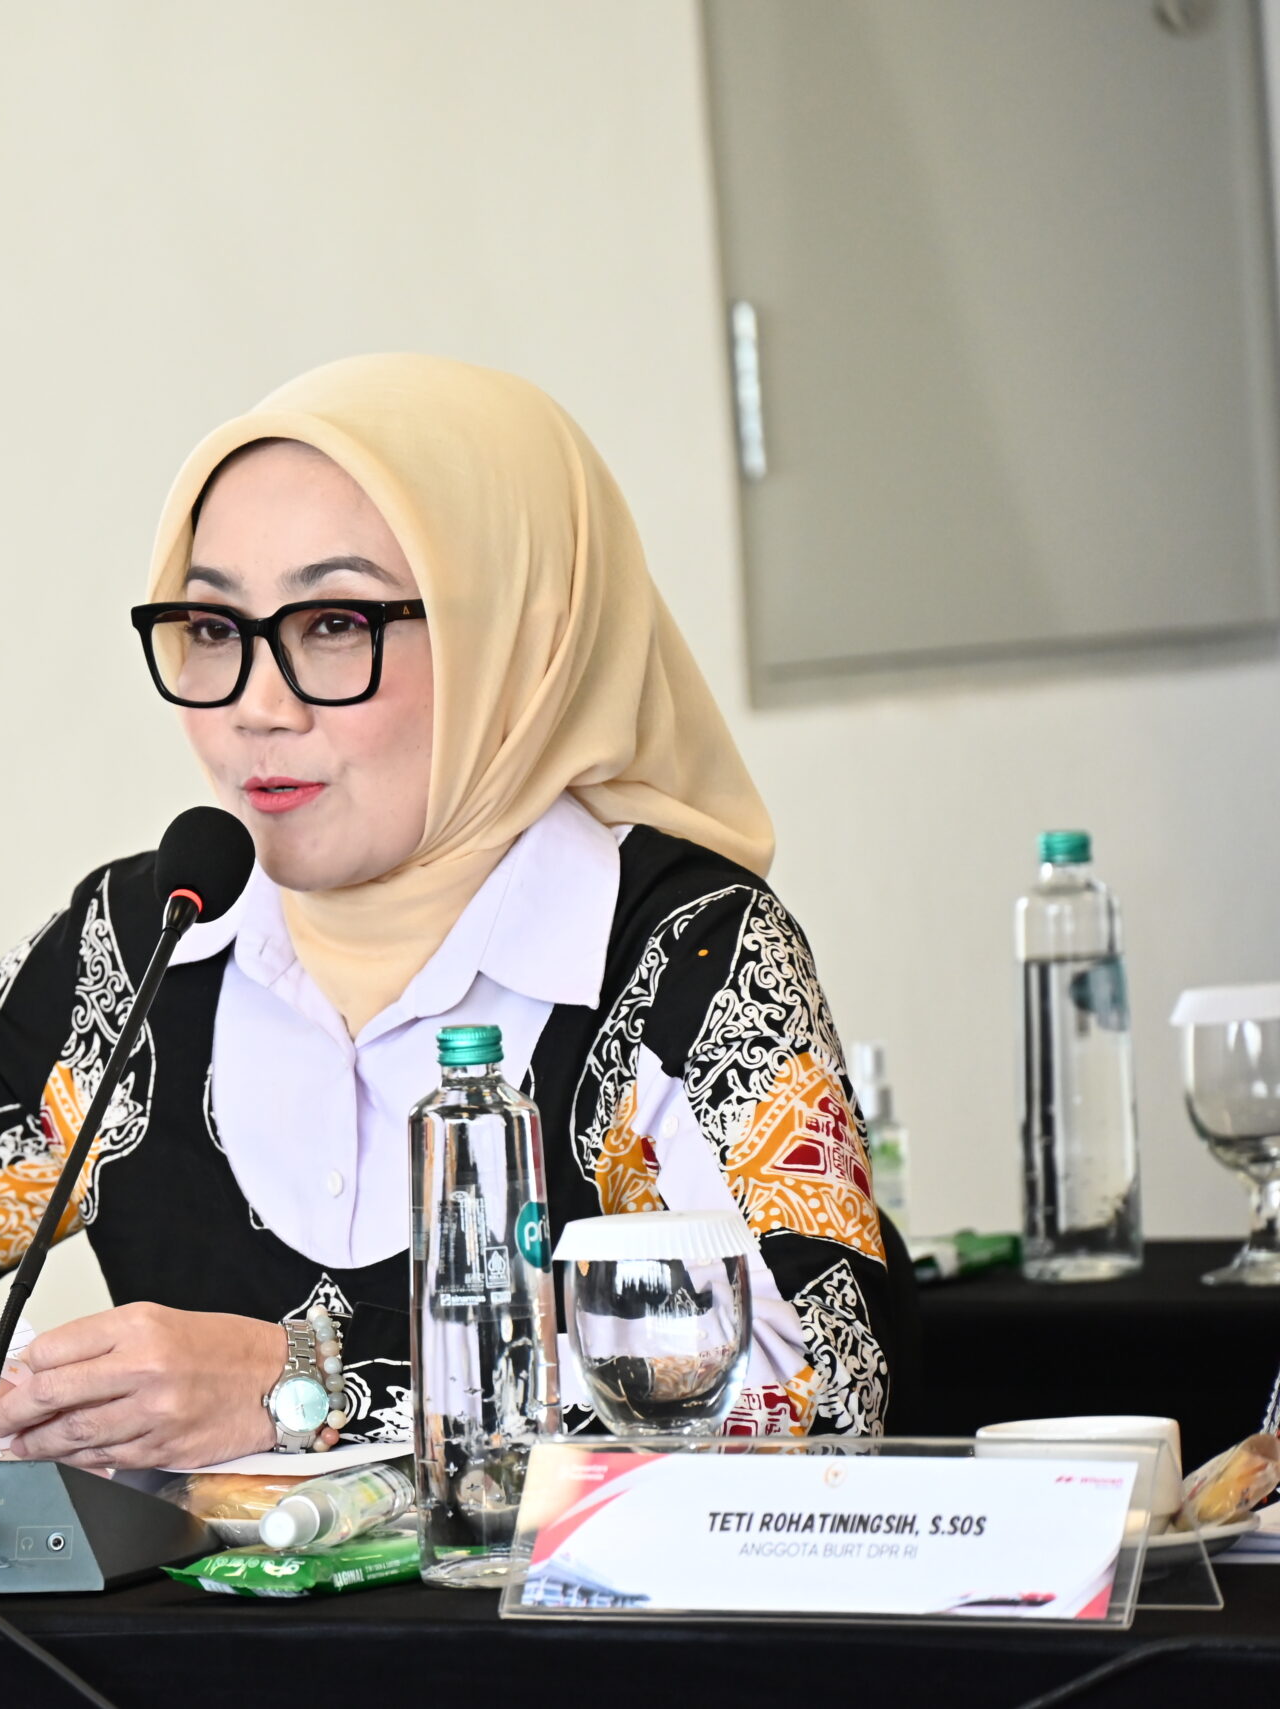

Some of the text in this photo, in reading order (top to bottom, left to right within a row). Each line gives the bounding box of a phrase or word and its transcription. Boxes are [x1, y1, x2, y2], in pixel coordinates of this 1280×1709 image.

[708, 1511, 988, 1537] TETI ROHATININGSIH, S.SOS
[738, 1541, 919, 1560] ANGGOTA BURT DPR RI
